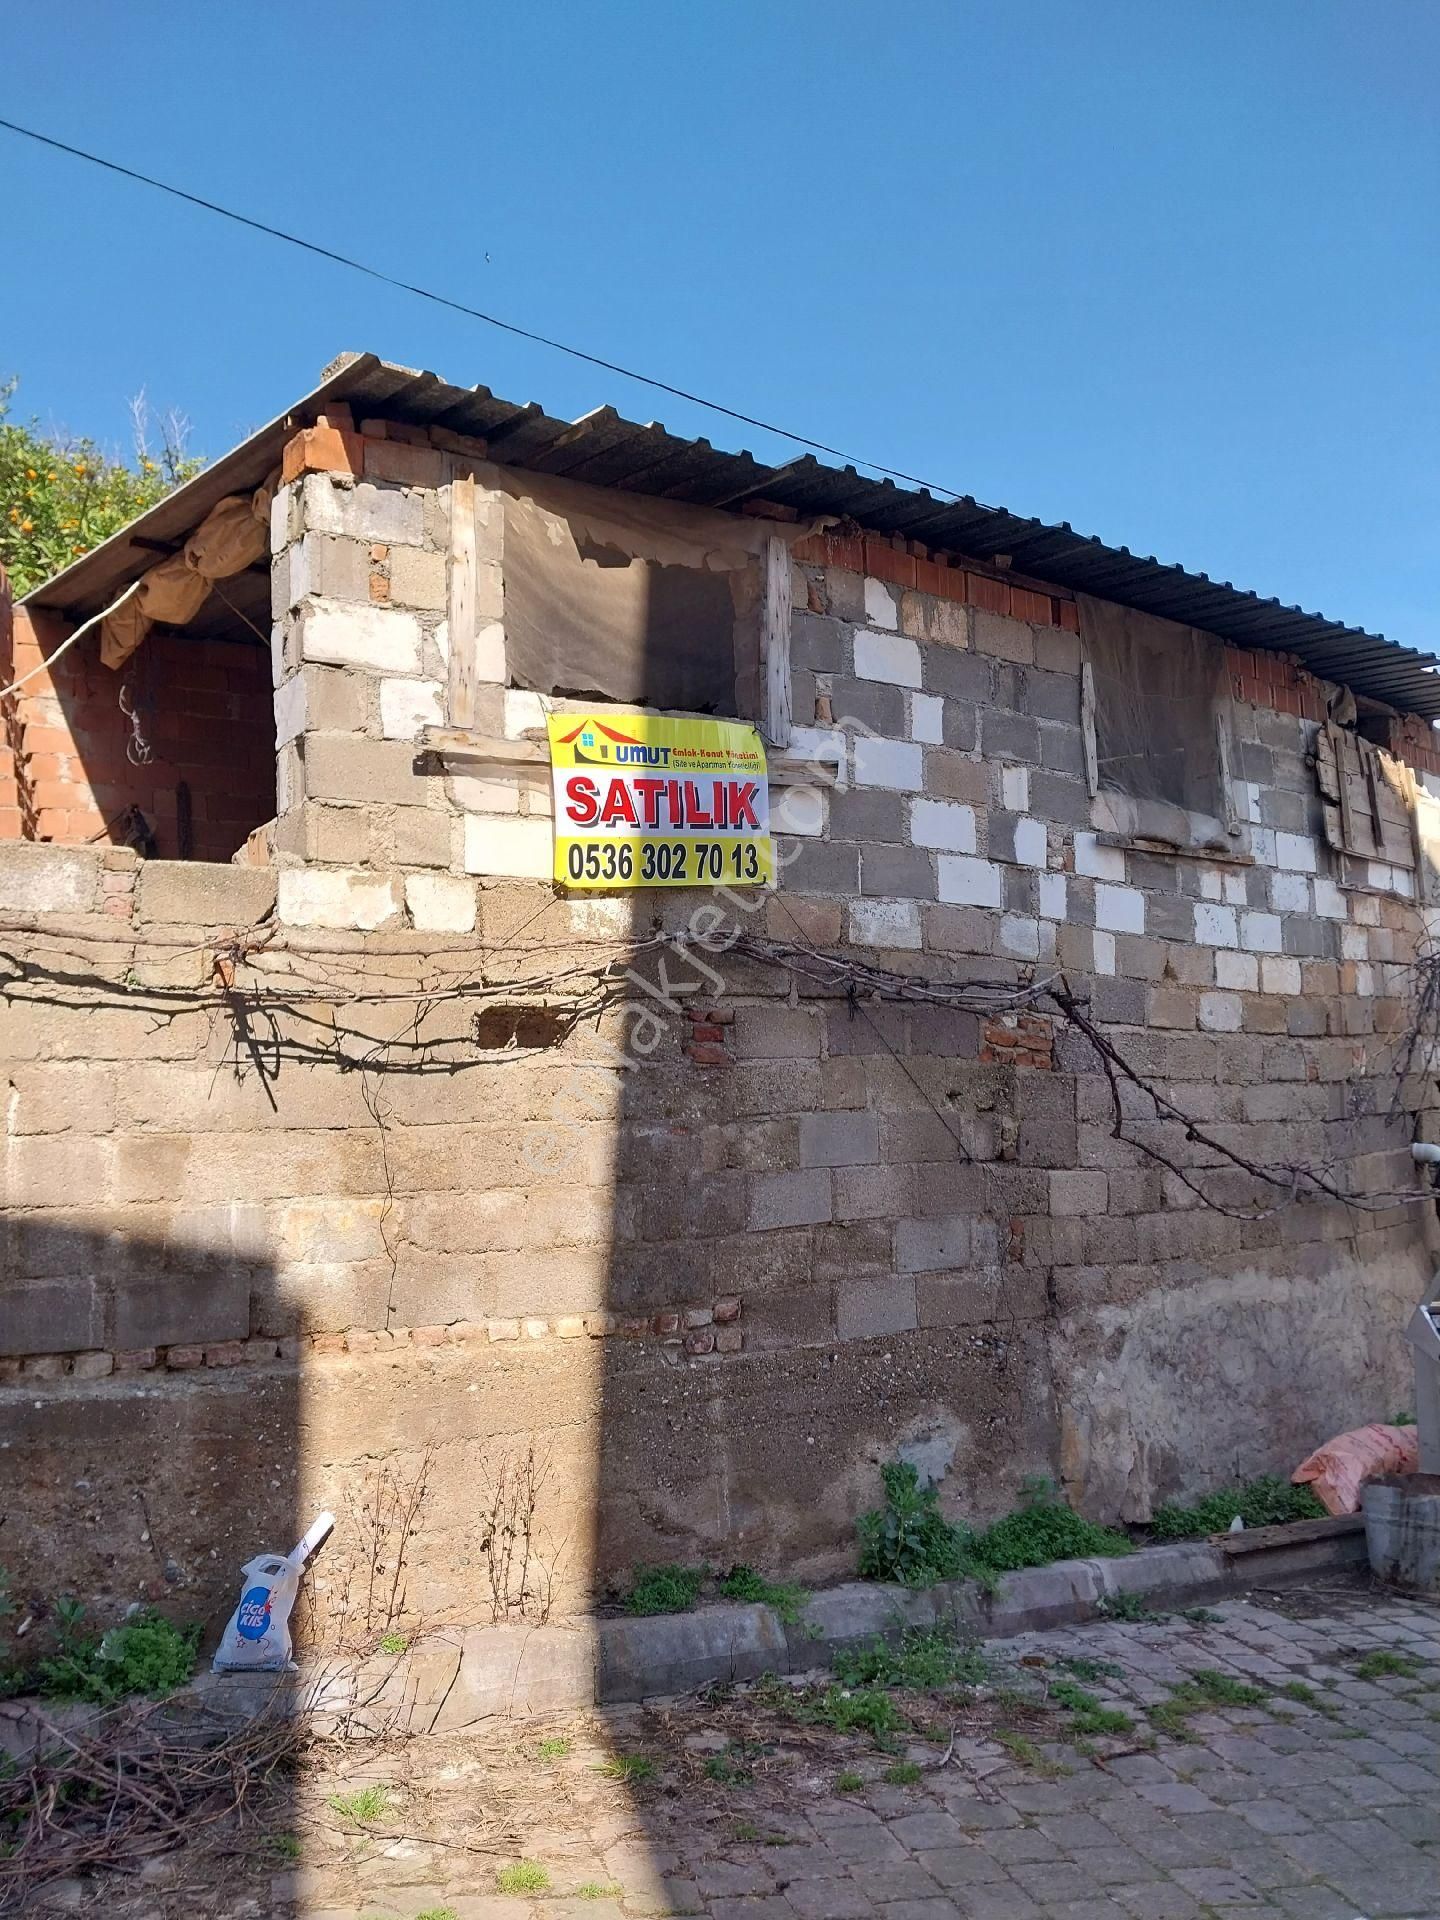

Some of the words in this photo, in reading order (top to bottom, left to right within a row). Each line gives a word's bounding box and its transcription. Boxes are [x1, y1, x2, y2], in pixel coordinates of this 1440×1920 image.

[616, 745, 671, 764] UMUT
[697, 760, 727, 770] Apartman
[566, 777, 761, 829] SATILIK
[568, 843, 633, 880] 0536
[641, 842, 687, 879] 302
[695, 843, 723, 879] 70
[731, 843, 759, 879] 13
